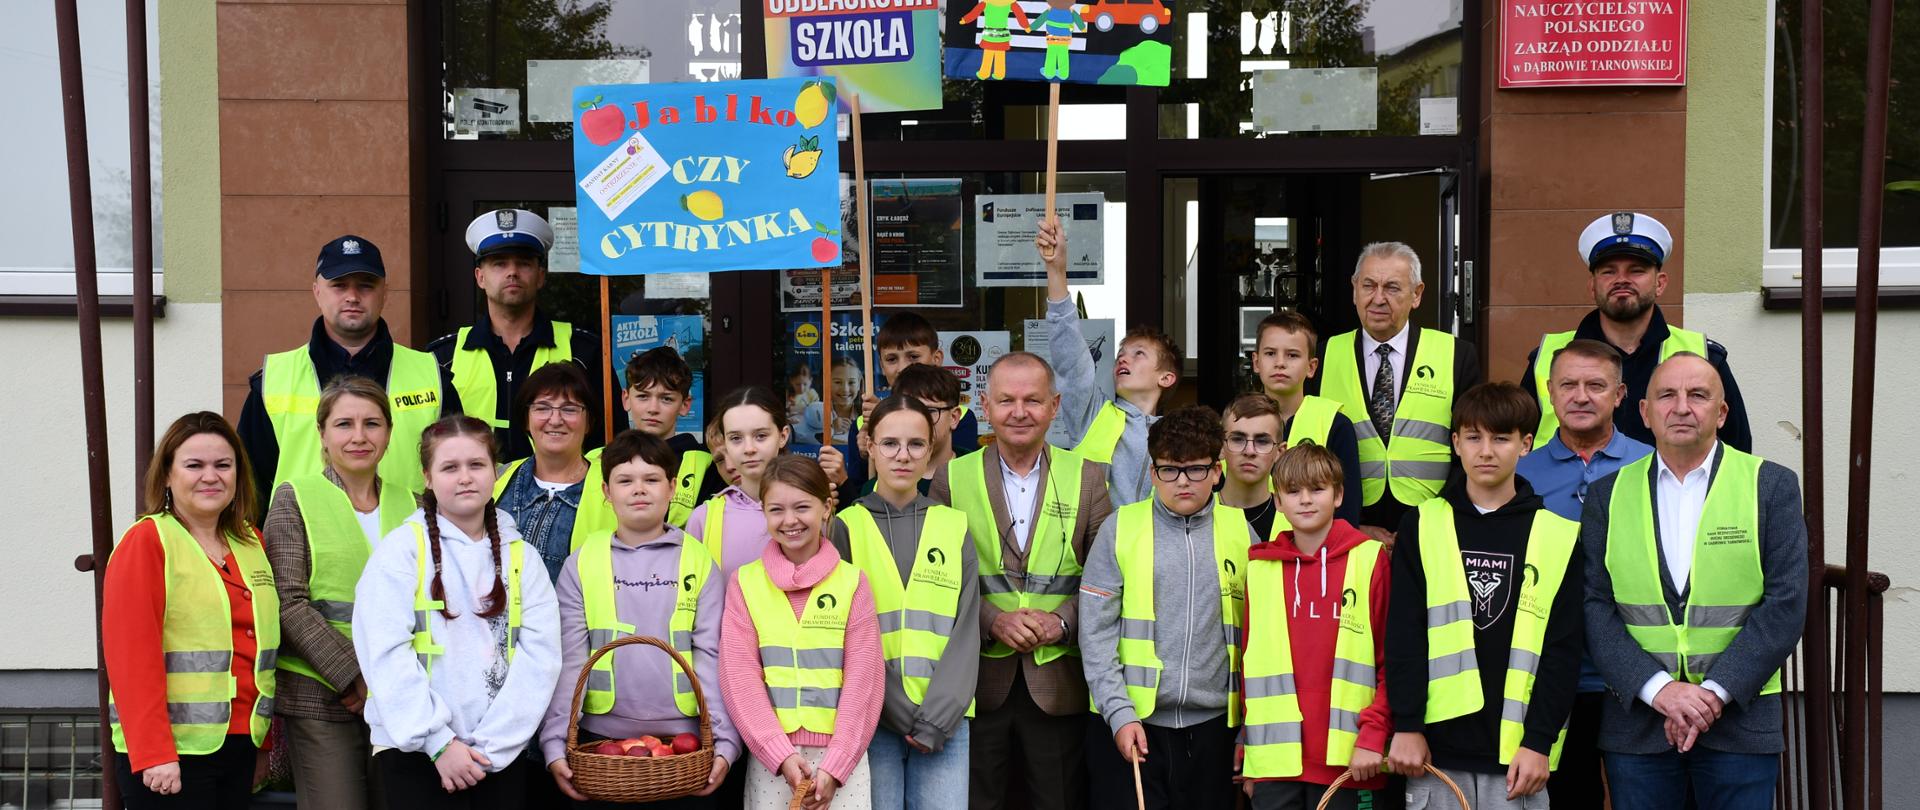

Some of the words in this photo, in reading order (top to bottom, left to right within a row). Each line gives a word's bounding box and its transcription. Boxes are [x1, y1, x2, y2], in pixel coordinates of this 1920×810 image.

[1514, 2, 1673, 17] NAUCZYCIELSTWA
[1544, 19, 1645, 34] POLSKIEGO
[797, 17, 909, 61] SZKOŁA
[1514, 41, 1583, 56] ZARZĄD
[1587, 40, 1673, 53] ODDZIAŁU
[1524, 60, 1588, 75] DĄBROWIE
[1590, 59, 1673, 72] TARNOWSKIEJ
[672, 155, 750, 185] CZY
[601, 207, 812, 259] CYTRYNKA
[616, 327, 659, 343] SZKOŁA
[395, 391, 437, 408] POLICJA
[1465, 557, 1507, 570] MIAMI
